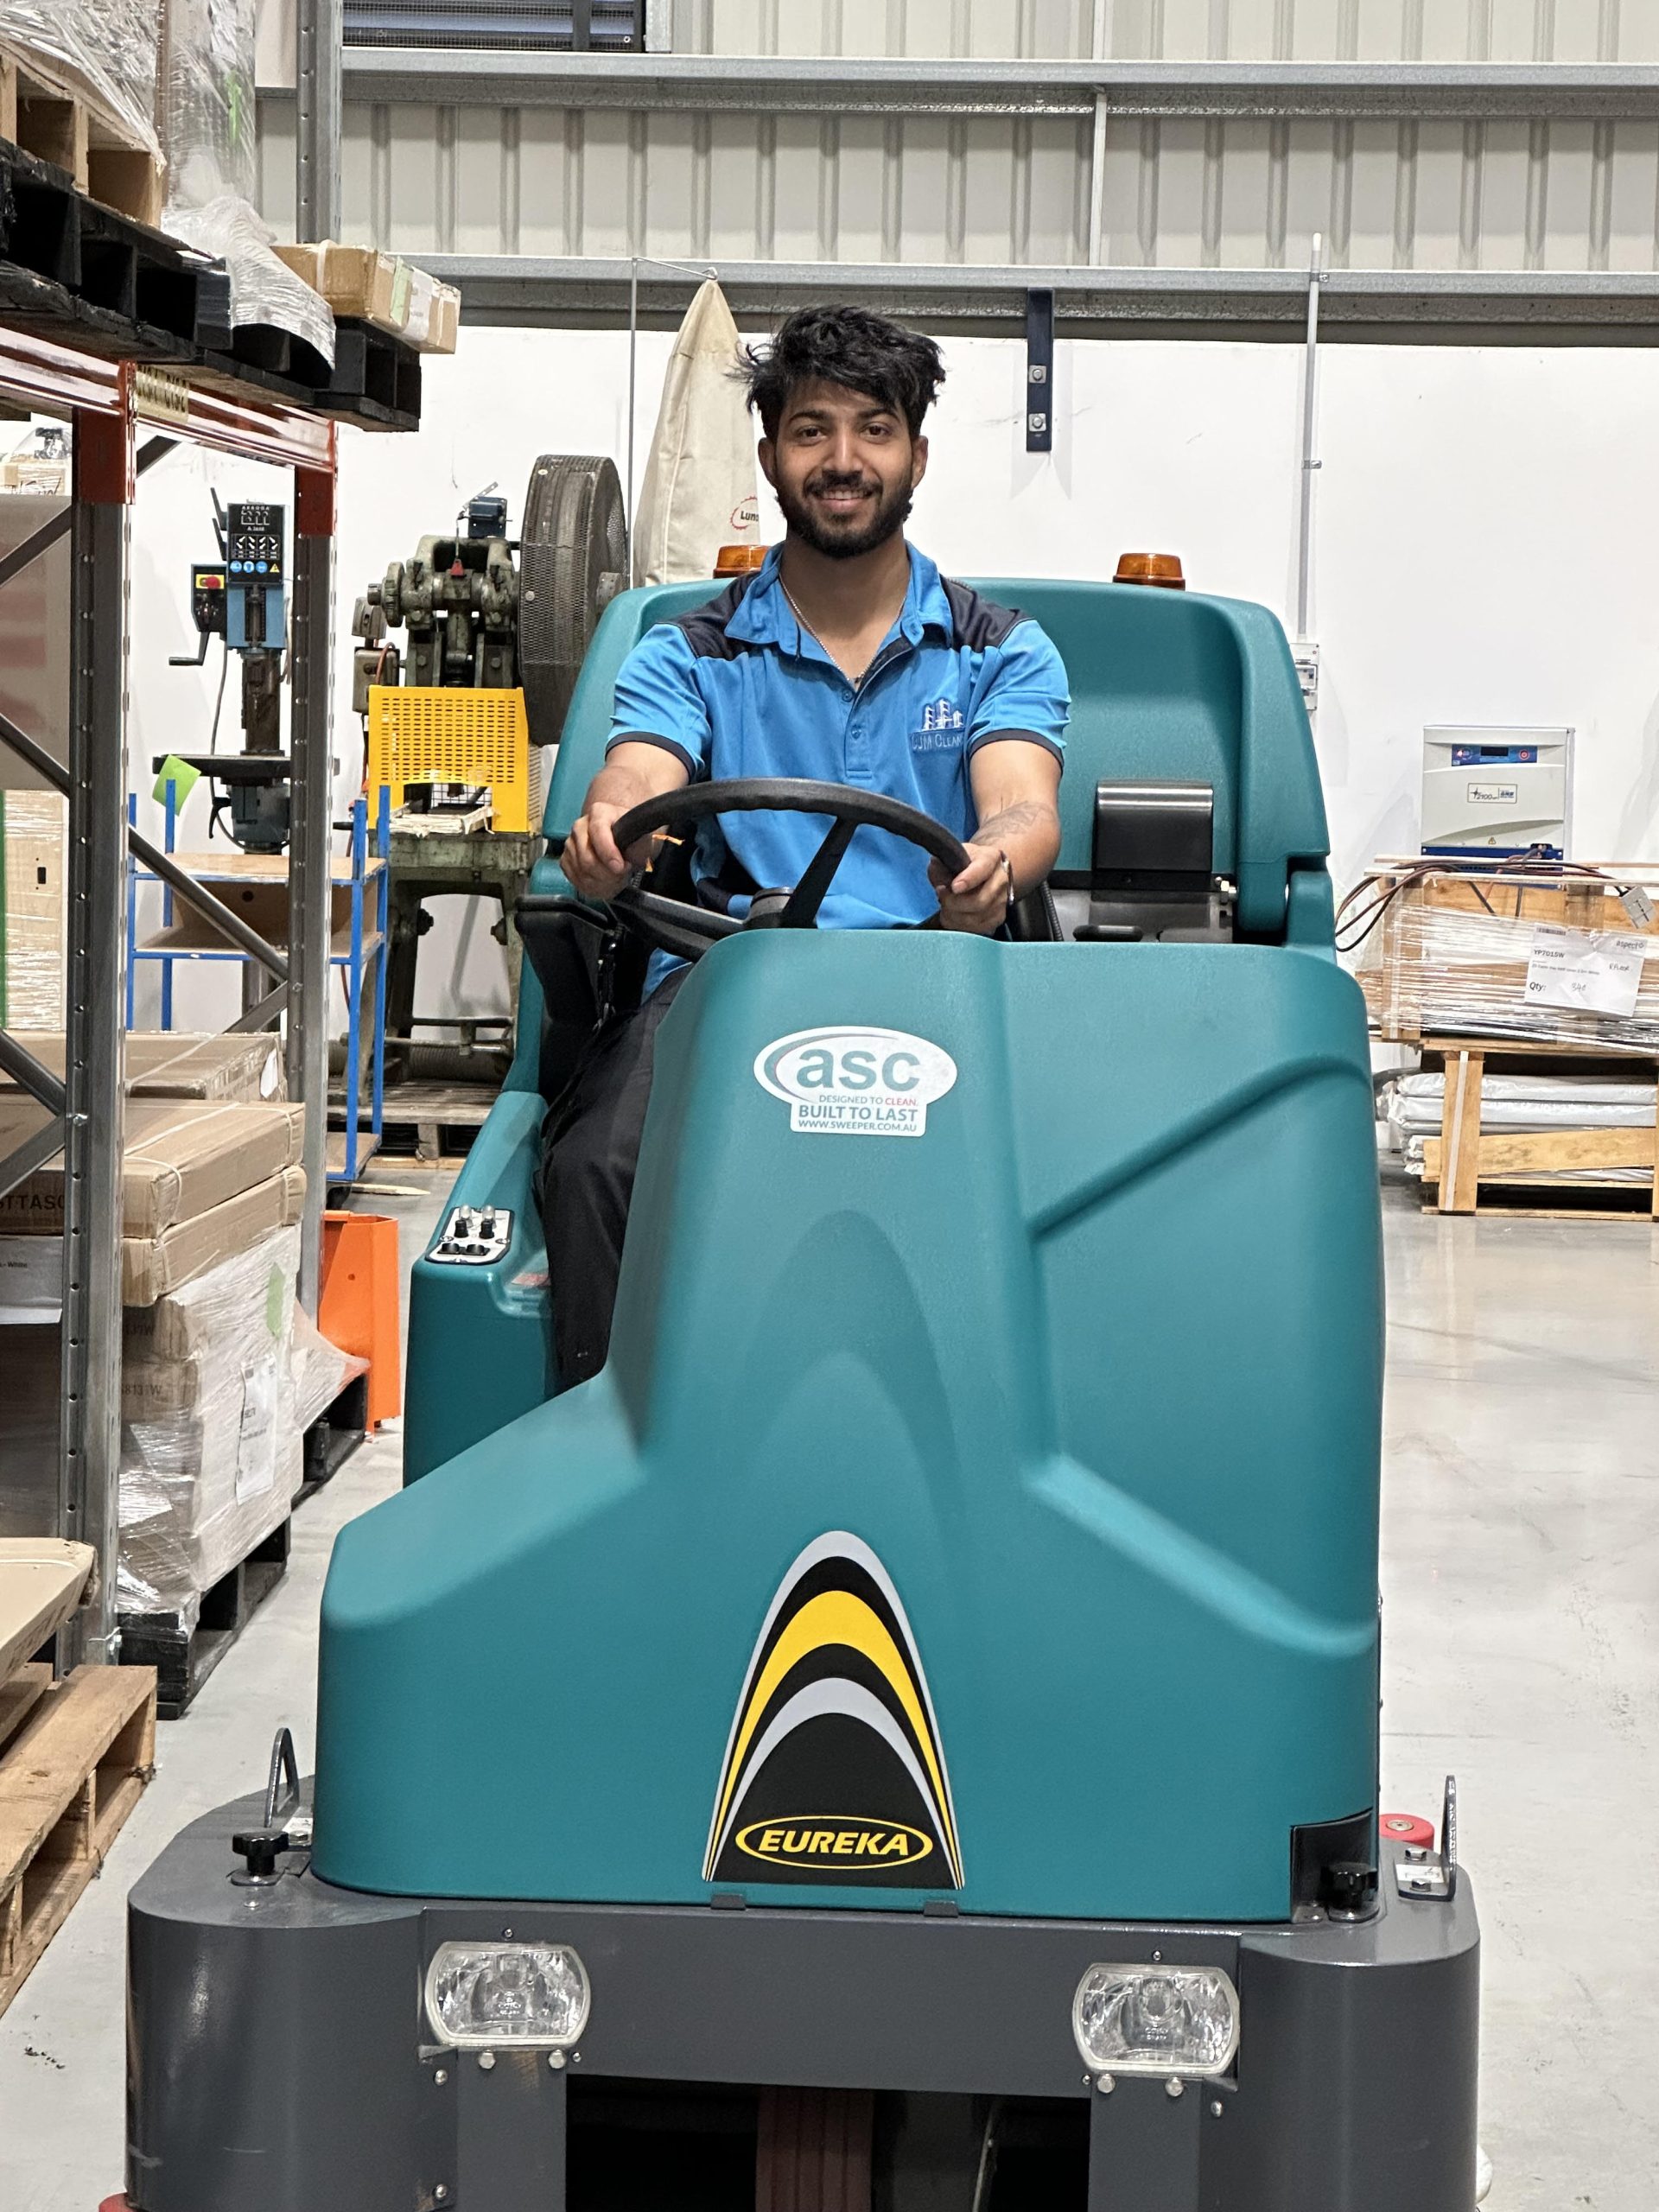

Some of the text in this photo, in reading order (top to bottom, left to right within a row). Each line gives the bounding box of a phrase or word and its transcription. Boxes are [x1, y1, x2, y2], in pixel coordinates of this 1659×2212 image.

[796, 1048, 921, 1092] asc
[819, 1094, 868, 1104] DESIGNED
[870, 1096, 883, 1105] TO
[799, 1104, 918, 1122] BUILT TO LAST
[798, 1120, 917, 1132] WWW.SWEEPER.COM.AU
[758, 1829, 909, 1856] EUREKA
